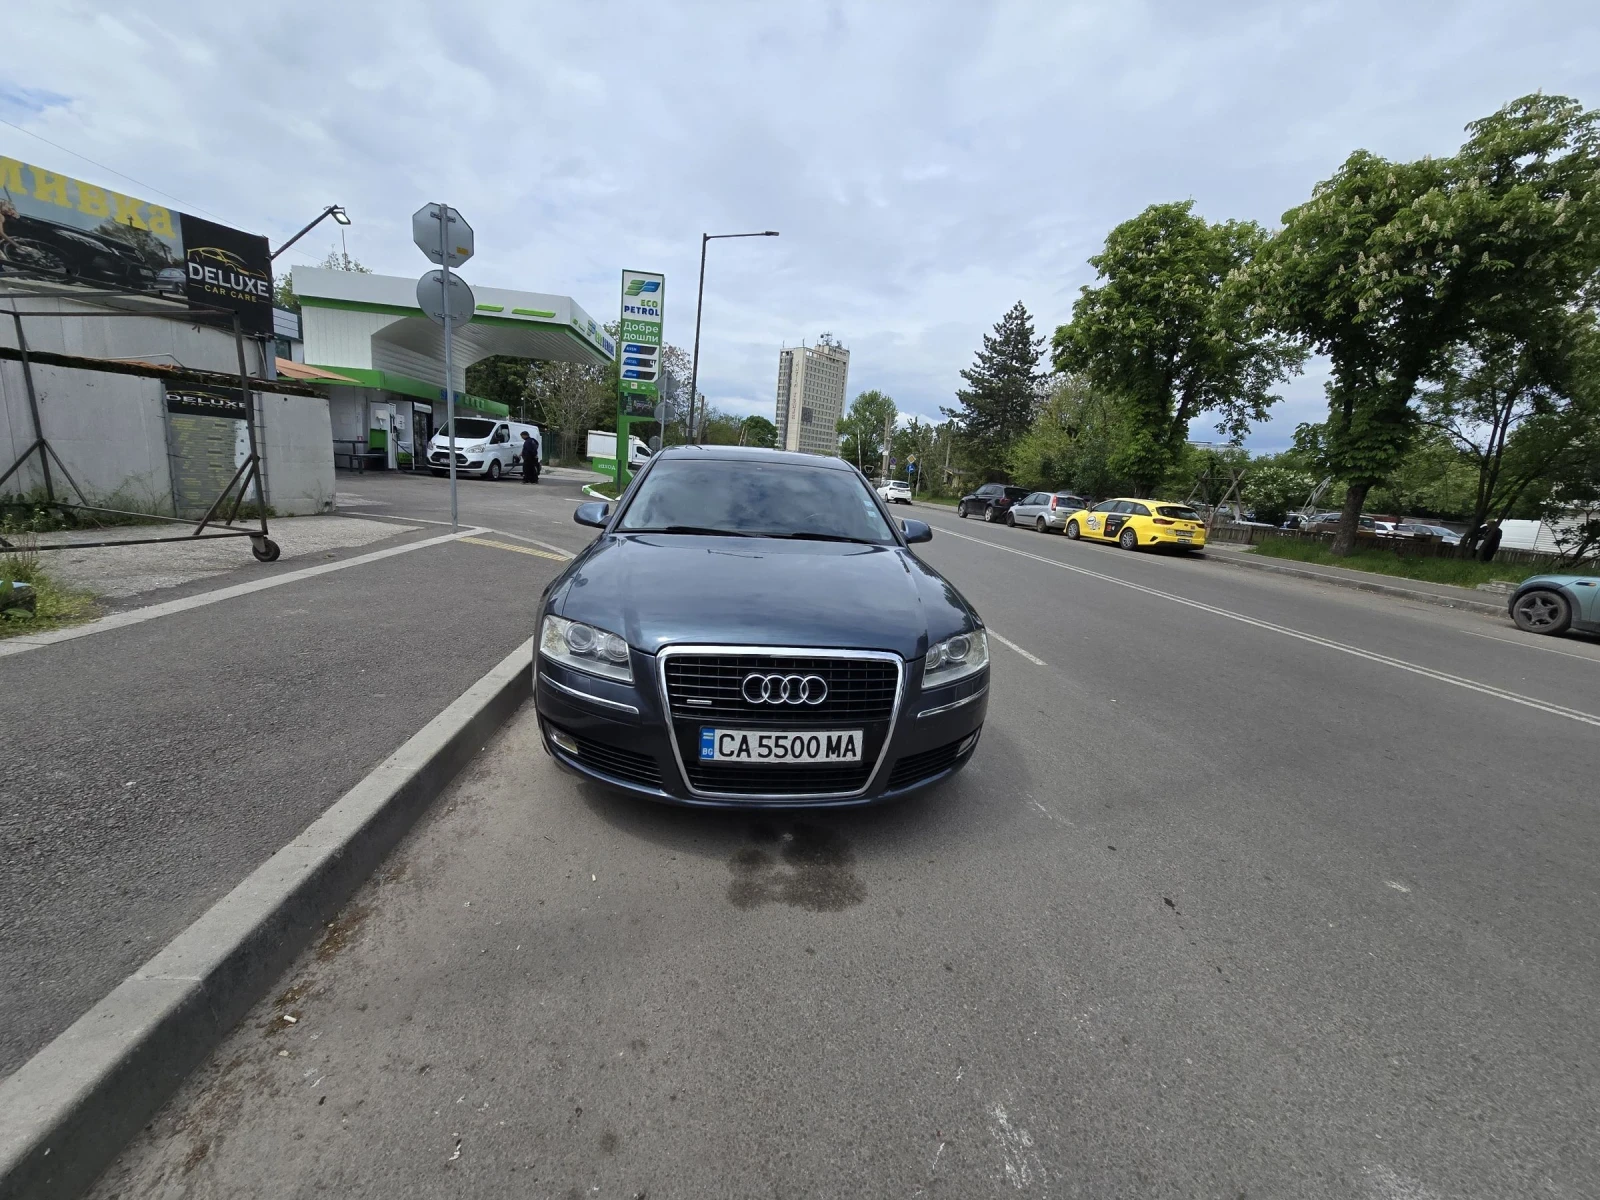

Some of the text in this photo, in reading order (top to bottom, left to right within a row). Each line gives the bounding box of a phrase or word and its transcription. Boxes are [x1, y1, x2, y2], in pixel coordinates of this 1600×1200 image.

[188, 262, 270, 297] DELUXE
[204, 285, 257, 302] CAR CARE
[640, 299, 658, 308] ECO
[624, 305, 660, 317] PETROL
[623, 321, 659, 334] Добре
[623, 332, 659, 343] дошли
[166, 394, 247, 409] DELUXE
[702, 747, 714, 756] BG
[719, 733, 857, 759] CA 5500 MA
